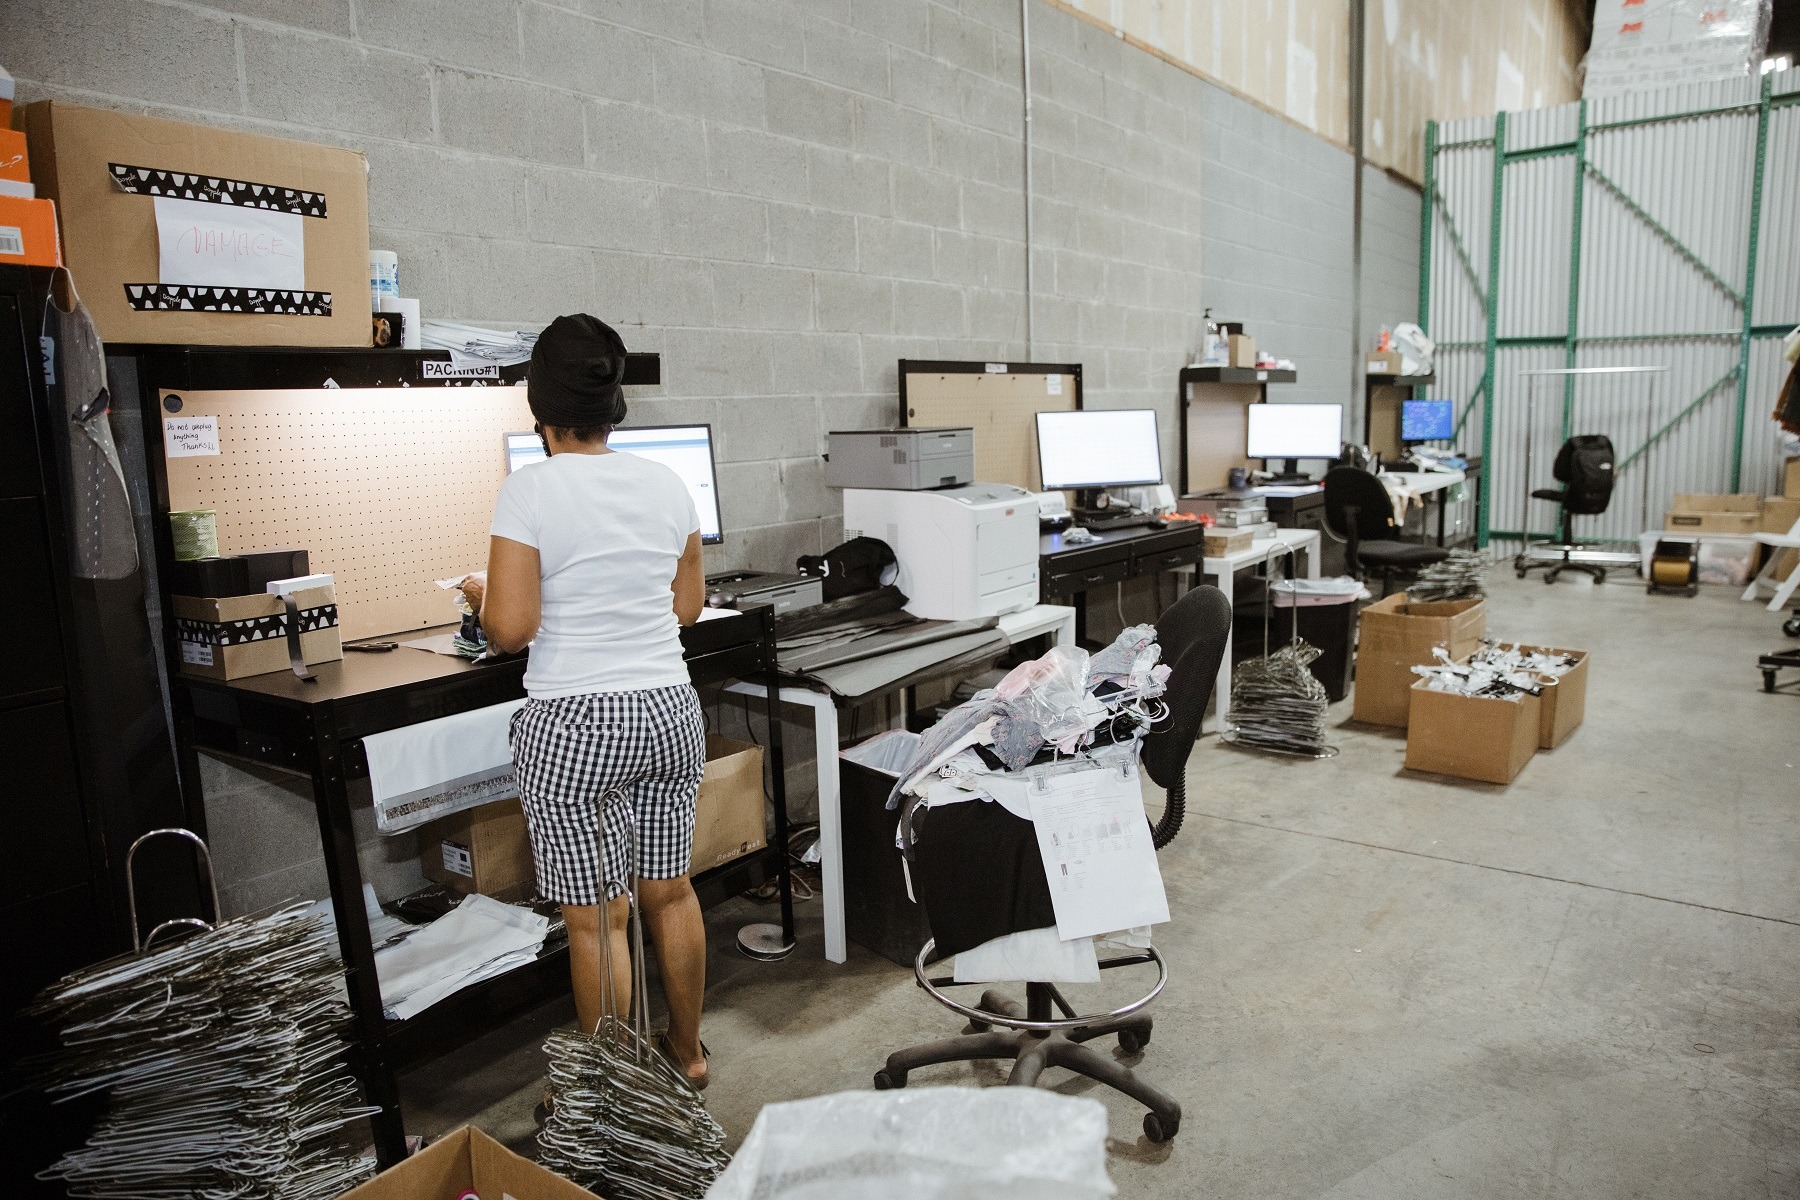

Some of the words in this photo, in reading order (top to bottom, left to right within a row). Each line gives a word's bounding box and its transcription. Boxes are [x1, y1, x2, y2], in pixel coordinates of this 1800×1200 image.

[177, 226, 294, 262] DAMAGE
[167, 422, 174, 430] Do
[177, 423, 189, 431] not
[716, 840, 761, 861] ReadyPost
